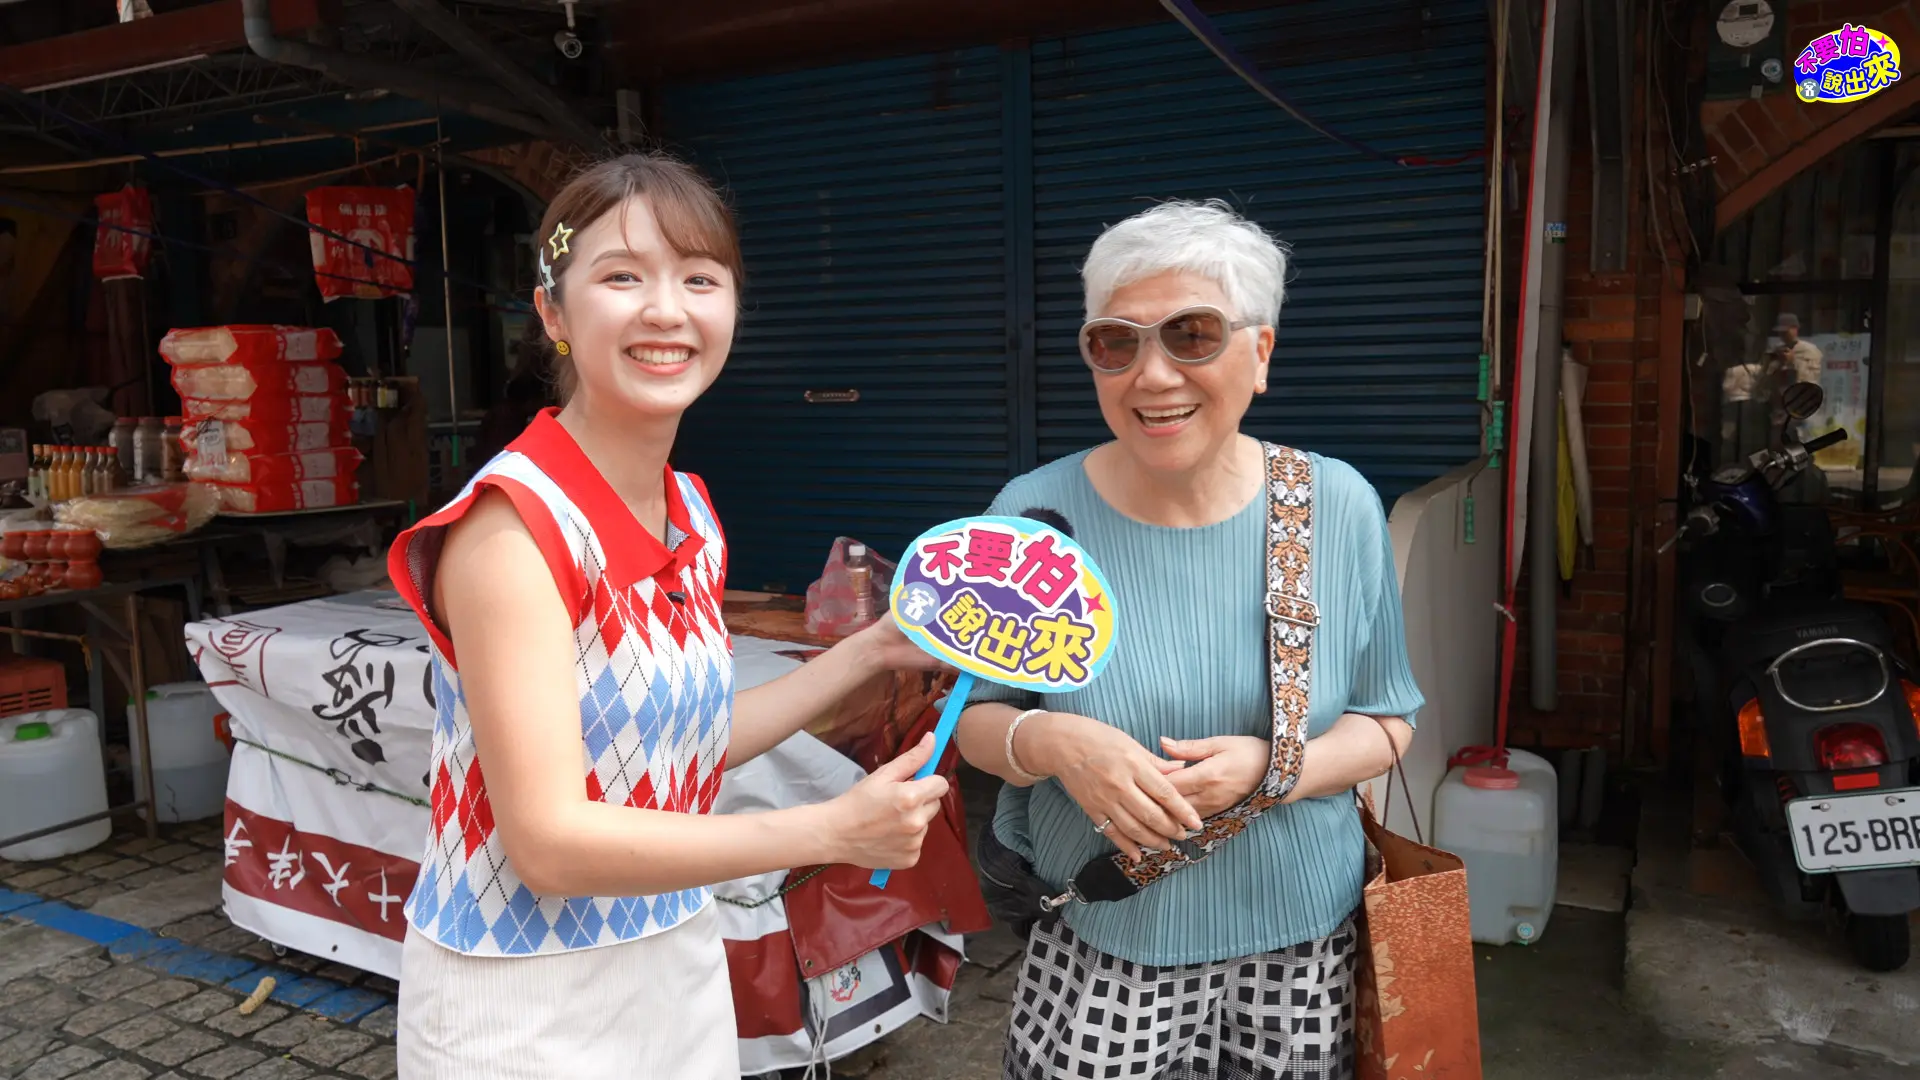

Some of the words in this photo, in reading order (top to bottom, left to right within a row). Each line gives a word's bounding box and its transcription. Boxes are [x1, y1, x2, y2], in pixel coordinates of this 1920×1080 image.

[904, 587, 935, 621] 客
[922, 528, 1078, 608] 不要怕
[941, 593, 1095, 682] 說出來
